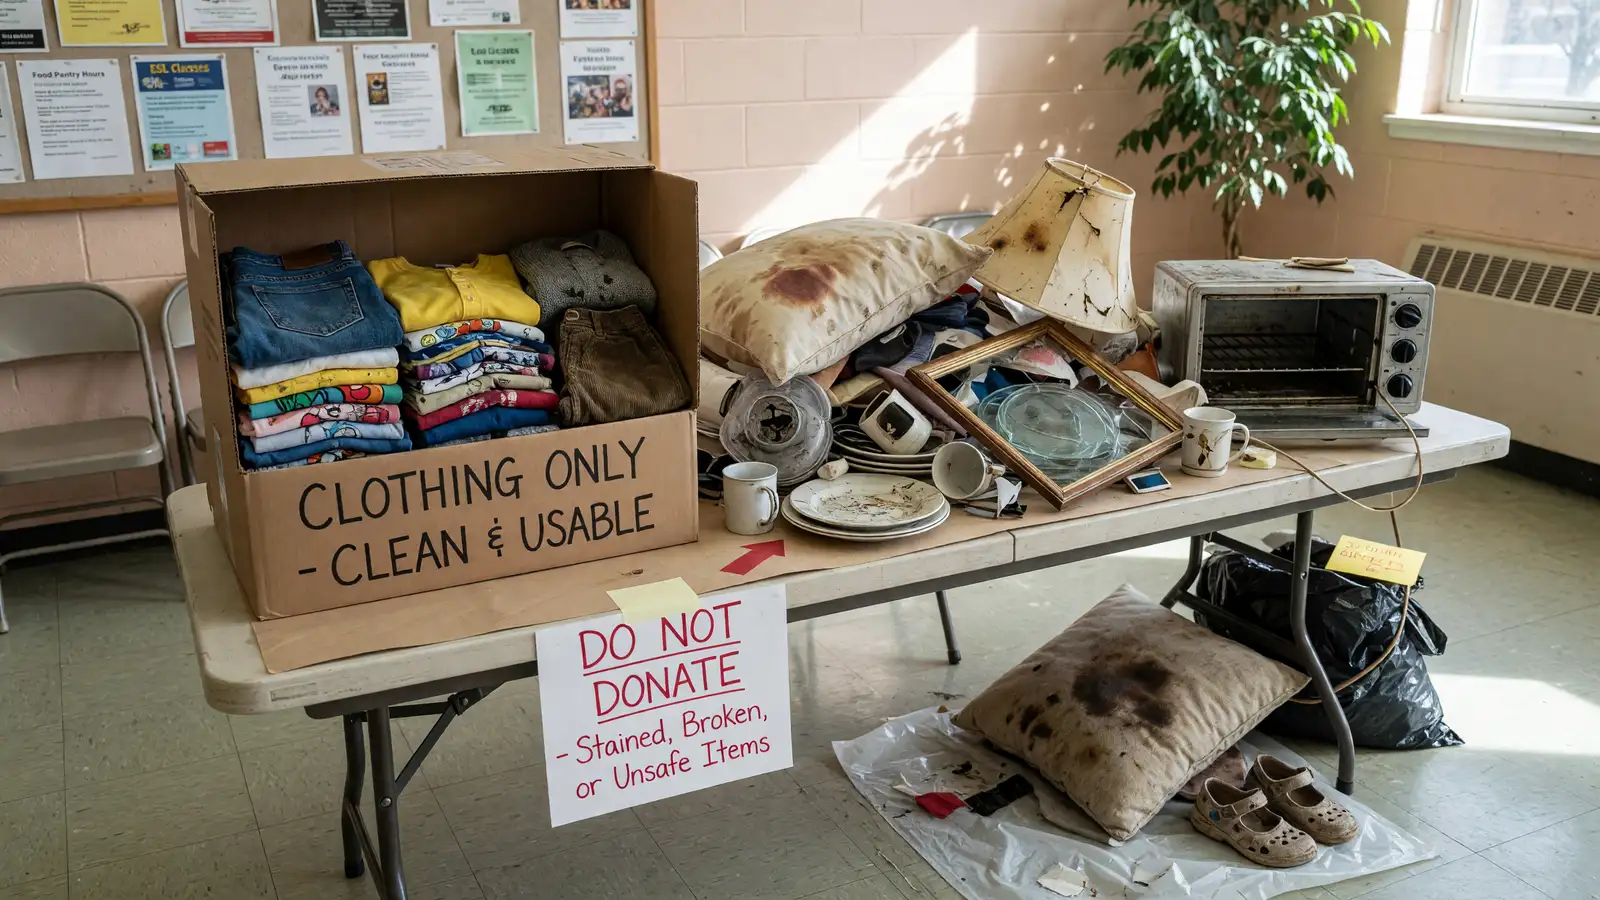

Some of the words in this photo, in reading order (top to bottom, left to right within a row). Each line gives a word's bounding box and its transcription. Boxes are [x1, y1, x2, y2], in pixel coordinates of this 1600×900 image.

[54, 71, 80, 79] Pantry
[150, 63, 169, 74] ESL
[171, 63, 210, 73] Classes
[299, 456, 524, 531] CLOTHING
[545, 436, 646, 490] ONLY
[331, 525, 469, 587] CLEAN
[487, 516, 504, 558] &
[519, 492, 655, 552] USABLE
[578, 623, 636, 670] DO
[661, 600, 742, 652] NOT
[593, 650, 742, 717] DONATE
[576, 718, 673, 765] Stained,
[682, 703, 768, 738] Broken,
[576, 779, 602, 799] or
[613, 750, 692, 790] Unsafe
[701, 736, 771, 768] Items
